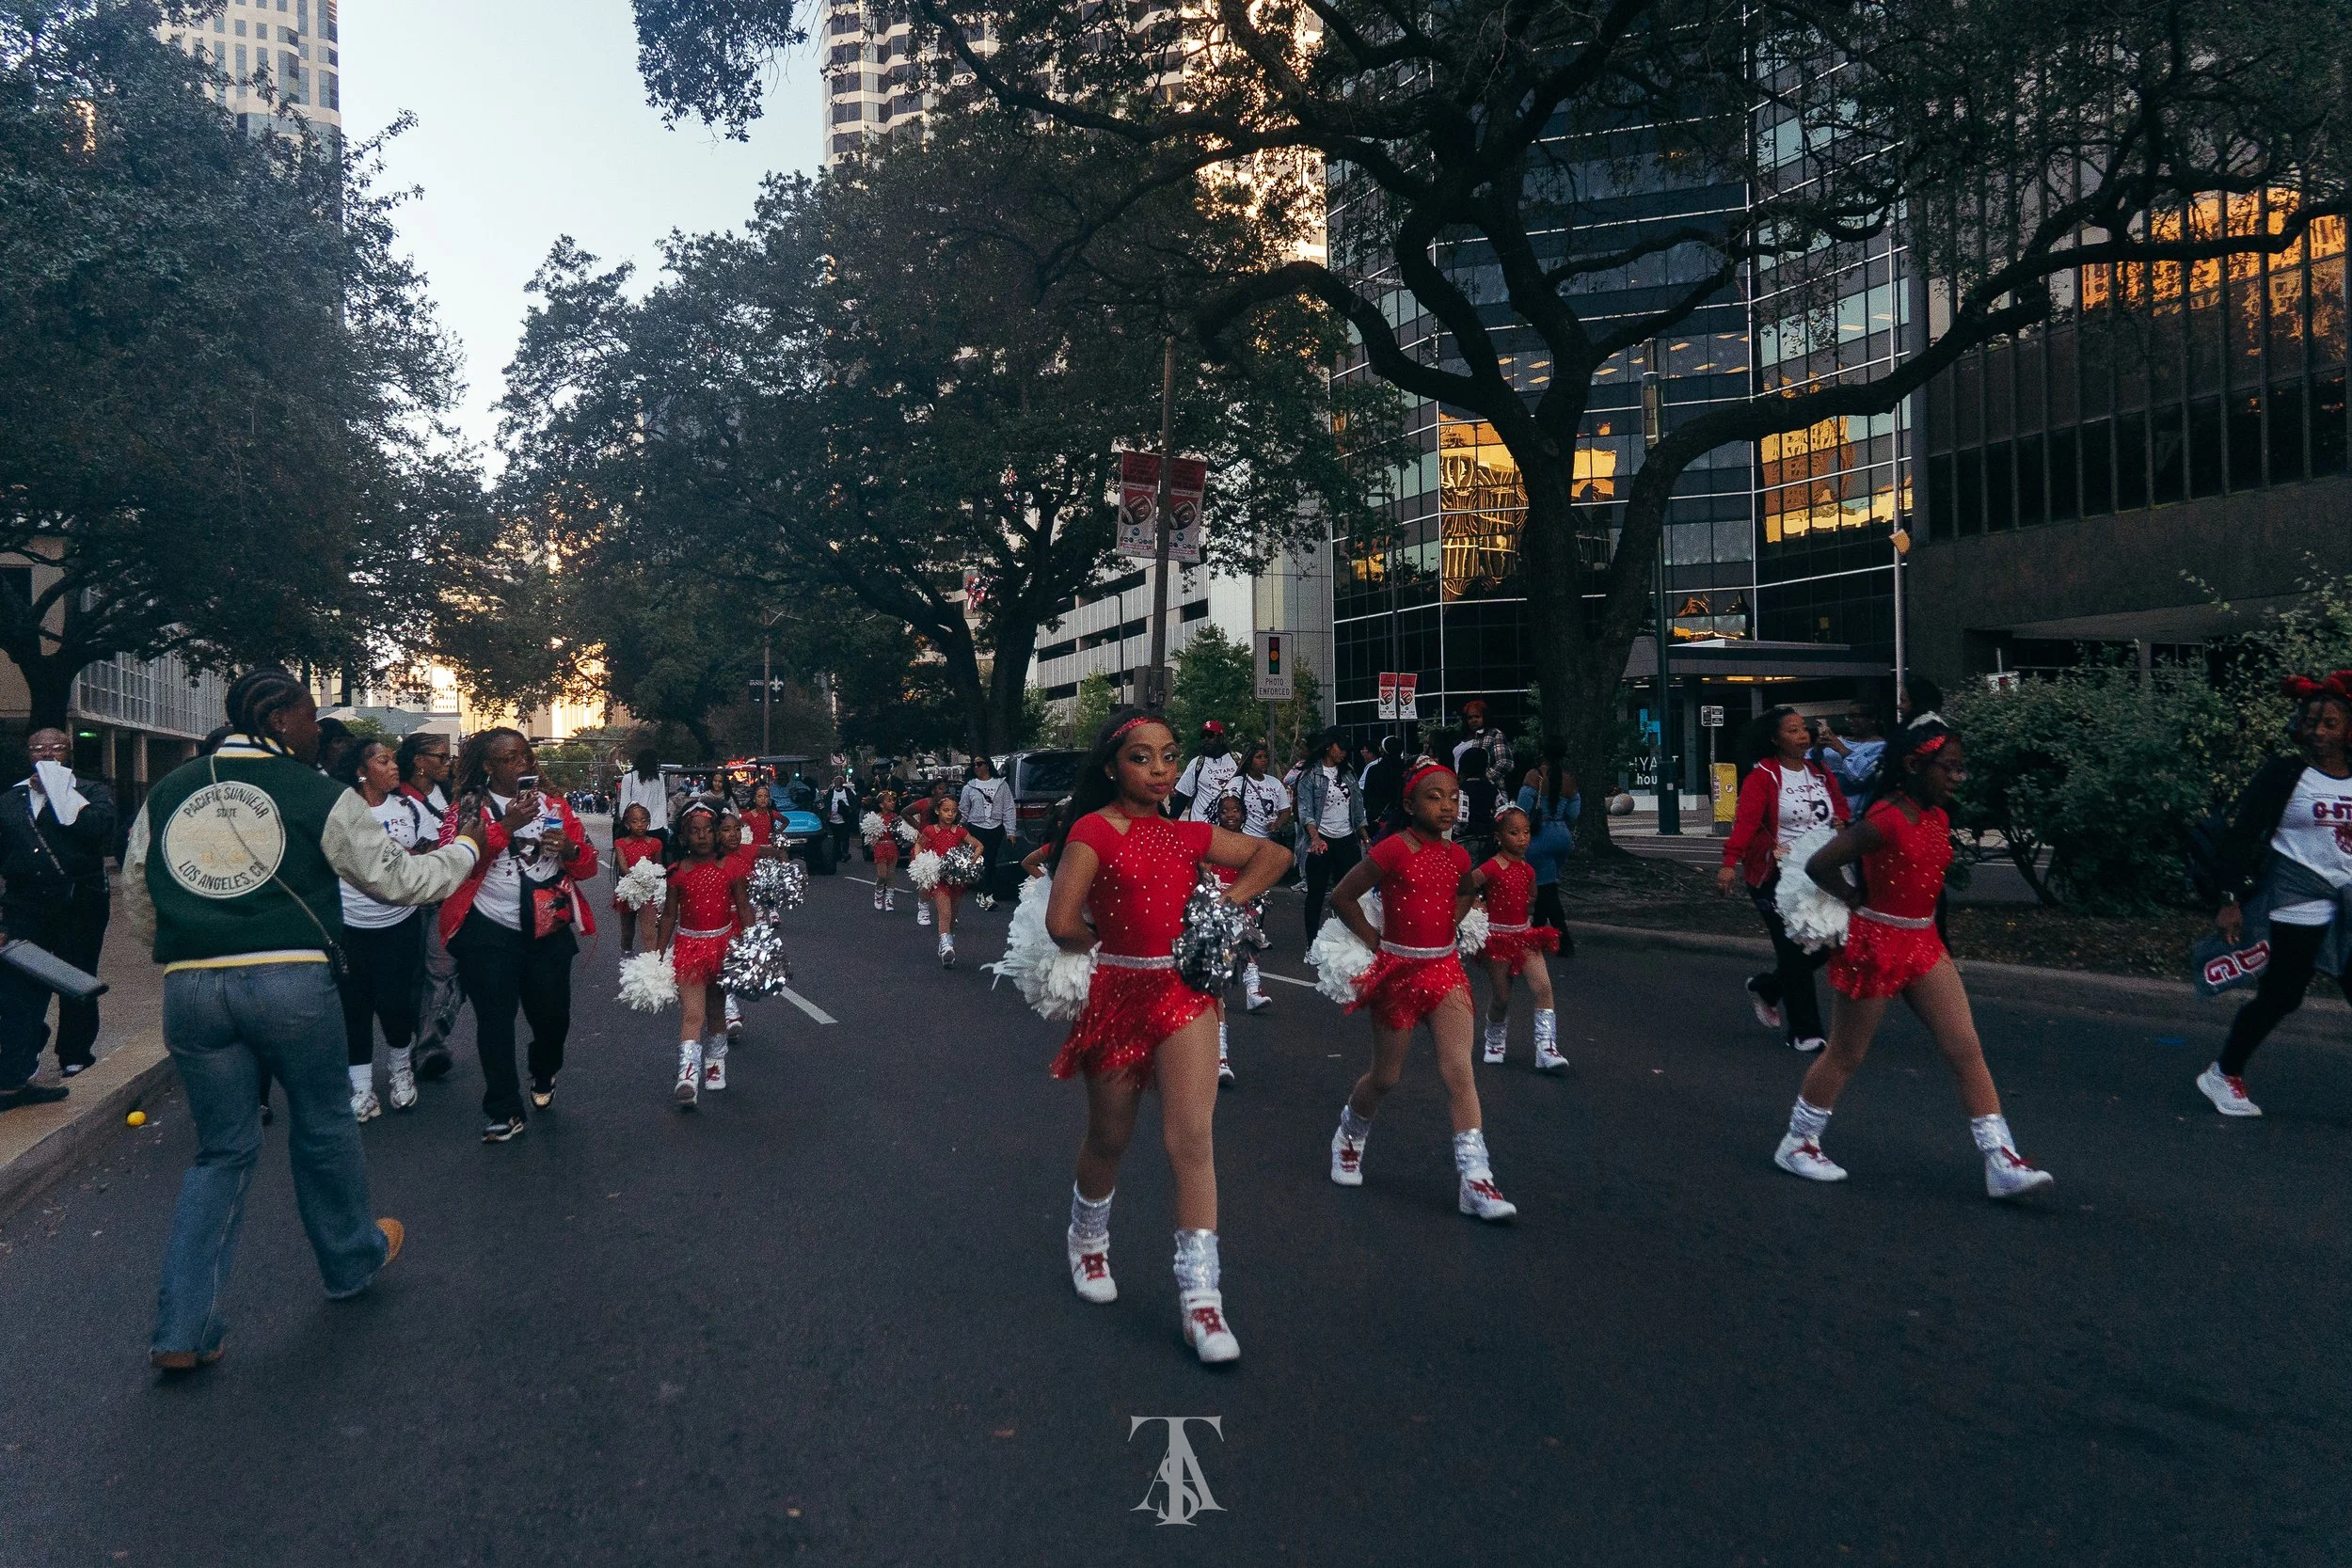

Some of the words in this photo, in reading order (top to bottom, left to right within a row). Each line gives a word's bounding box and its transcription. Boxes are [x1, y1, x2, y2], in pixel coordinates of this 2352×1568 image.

[1265, 677, 1284, 686] PHOTO
[1259, 688, 1290, 696] ENFORCED
[1629, 755, 1678, 772] HYAT
[1637, 773, 1658, 785] hou
[183, 788, 222, 818] PACIFIC
[225, 786, 269, 819] SUNWEAR
[179, 860, 201, 882] LOS
[198, 871, 255, 891] ANGELES,
